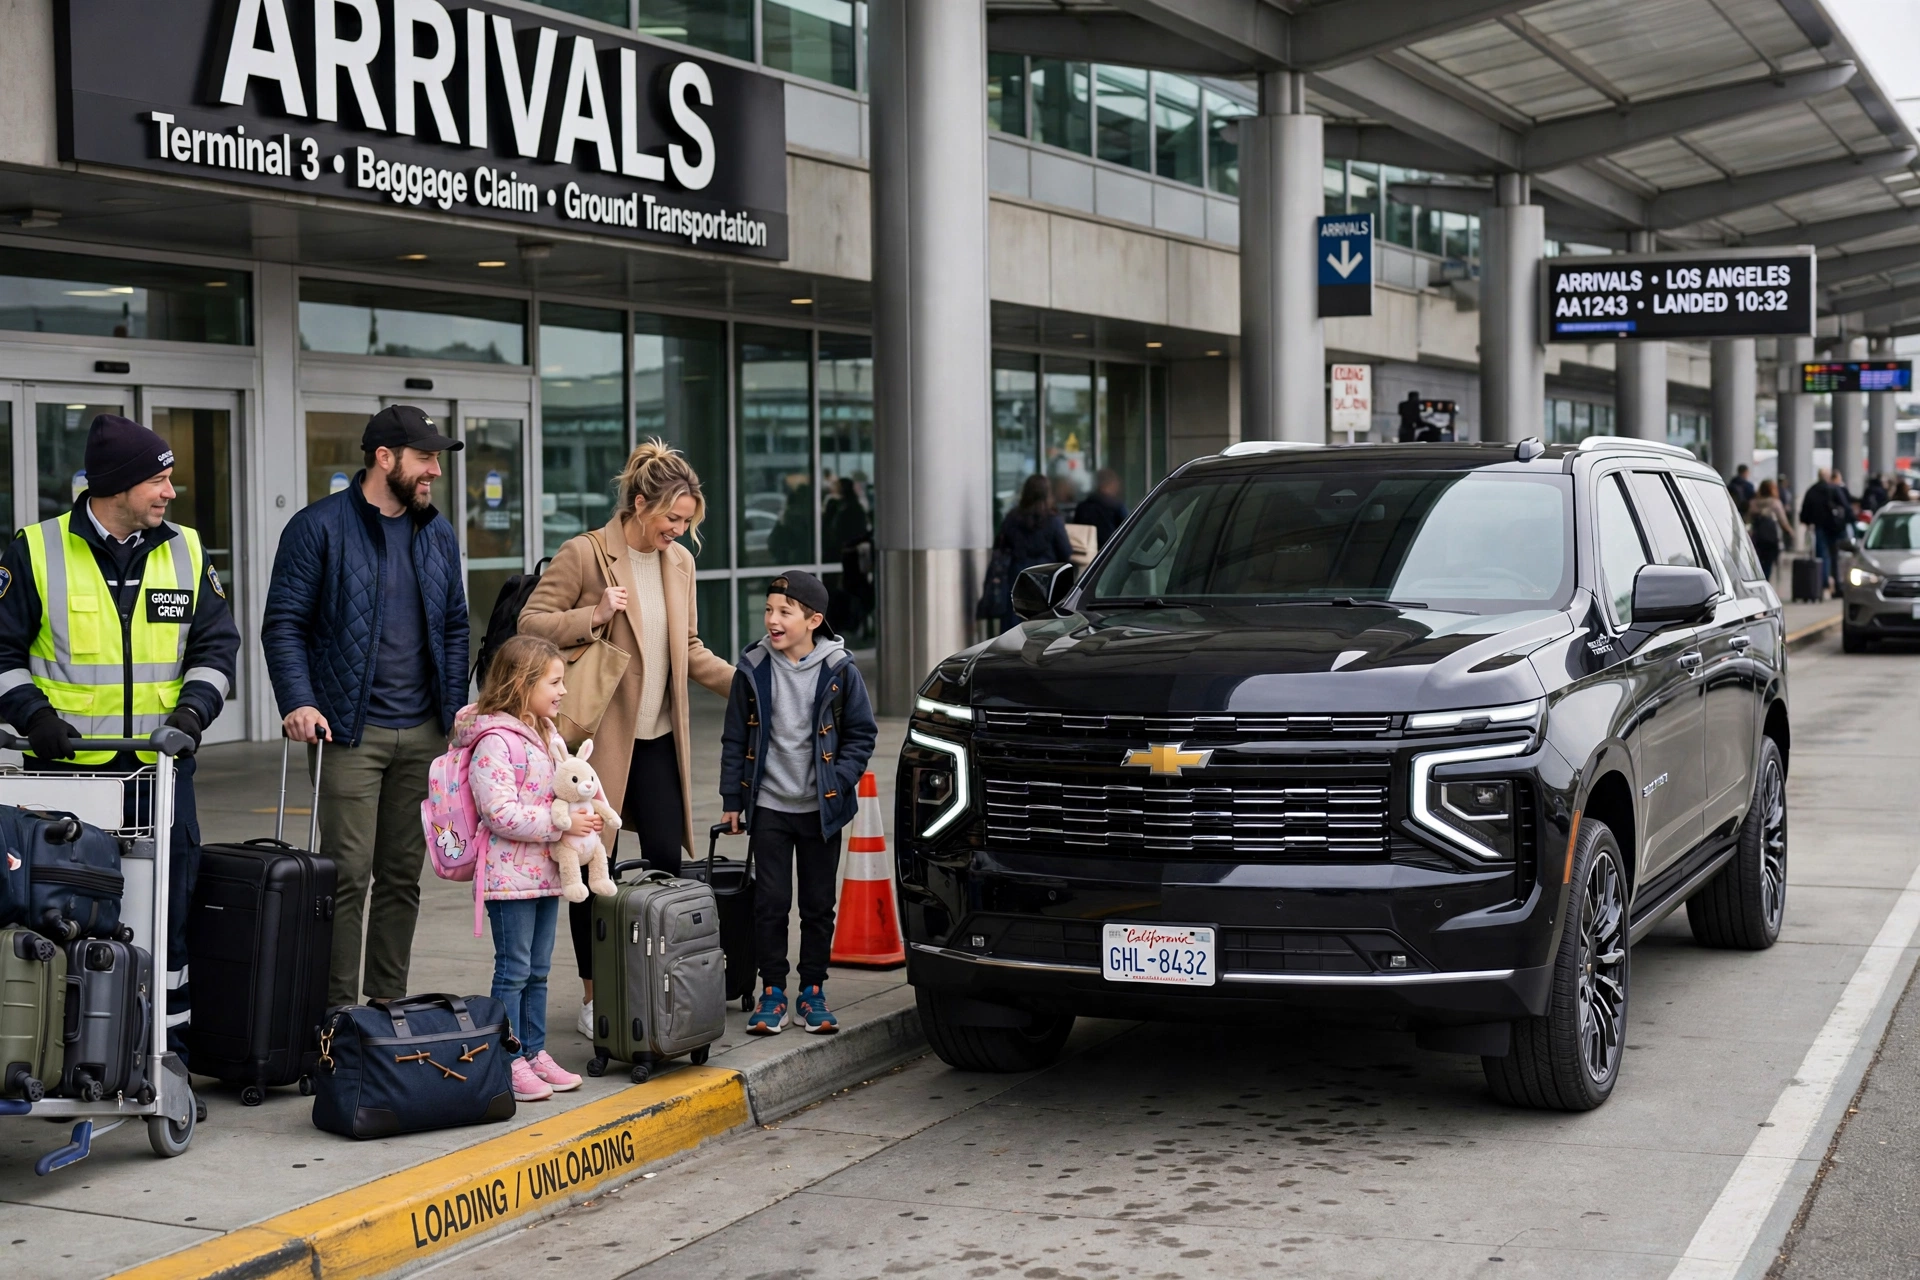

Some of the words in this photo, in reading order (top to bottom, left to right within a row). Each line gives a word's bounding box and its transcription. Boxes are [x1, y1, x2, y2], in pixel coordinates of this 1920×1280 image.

[220, 0, 716, 190] ARRIVALS
[151, 111, 291, 176] Terminal
[300, 137, 320, 181] 3
[357, 146, 467, 210] Baggage
[474, 166, 538, 213] Claim
[564, 181, 638, 228] Ground
[642, 194, 767, 247] Transportation
[1321, 221, 1369, 237] ARRIVALS
[1556, 270, 1643, 292] ARRIVALS
[1666, 268, 1702, 289] LOS
[1705, 265, 1791, 288] ANGELES
[1556, 295, 1629, 317] AA1243
[1653, 292, 1729, 314] LANDED
[1734, 289, 1788, 312] 10:32
[151, 592, 190, 605] GROUND
[157, 605, 185, 617] CREW
[1110, 946, 1208, 976] GHL-8432
[411, 1178, 509, 1248] LOADING
[528, 1130, 635, 1200] UNLOADING
